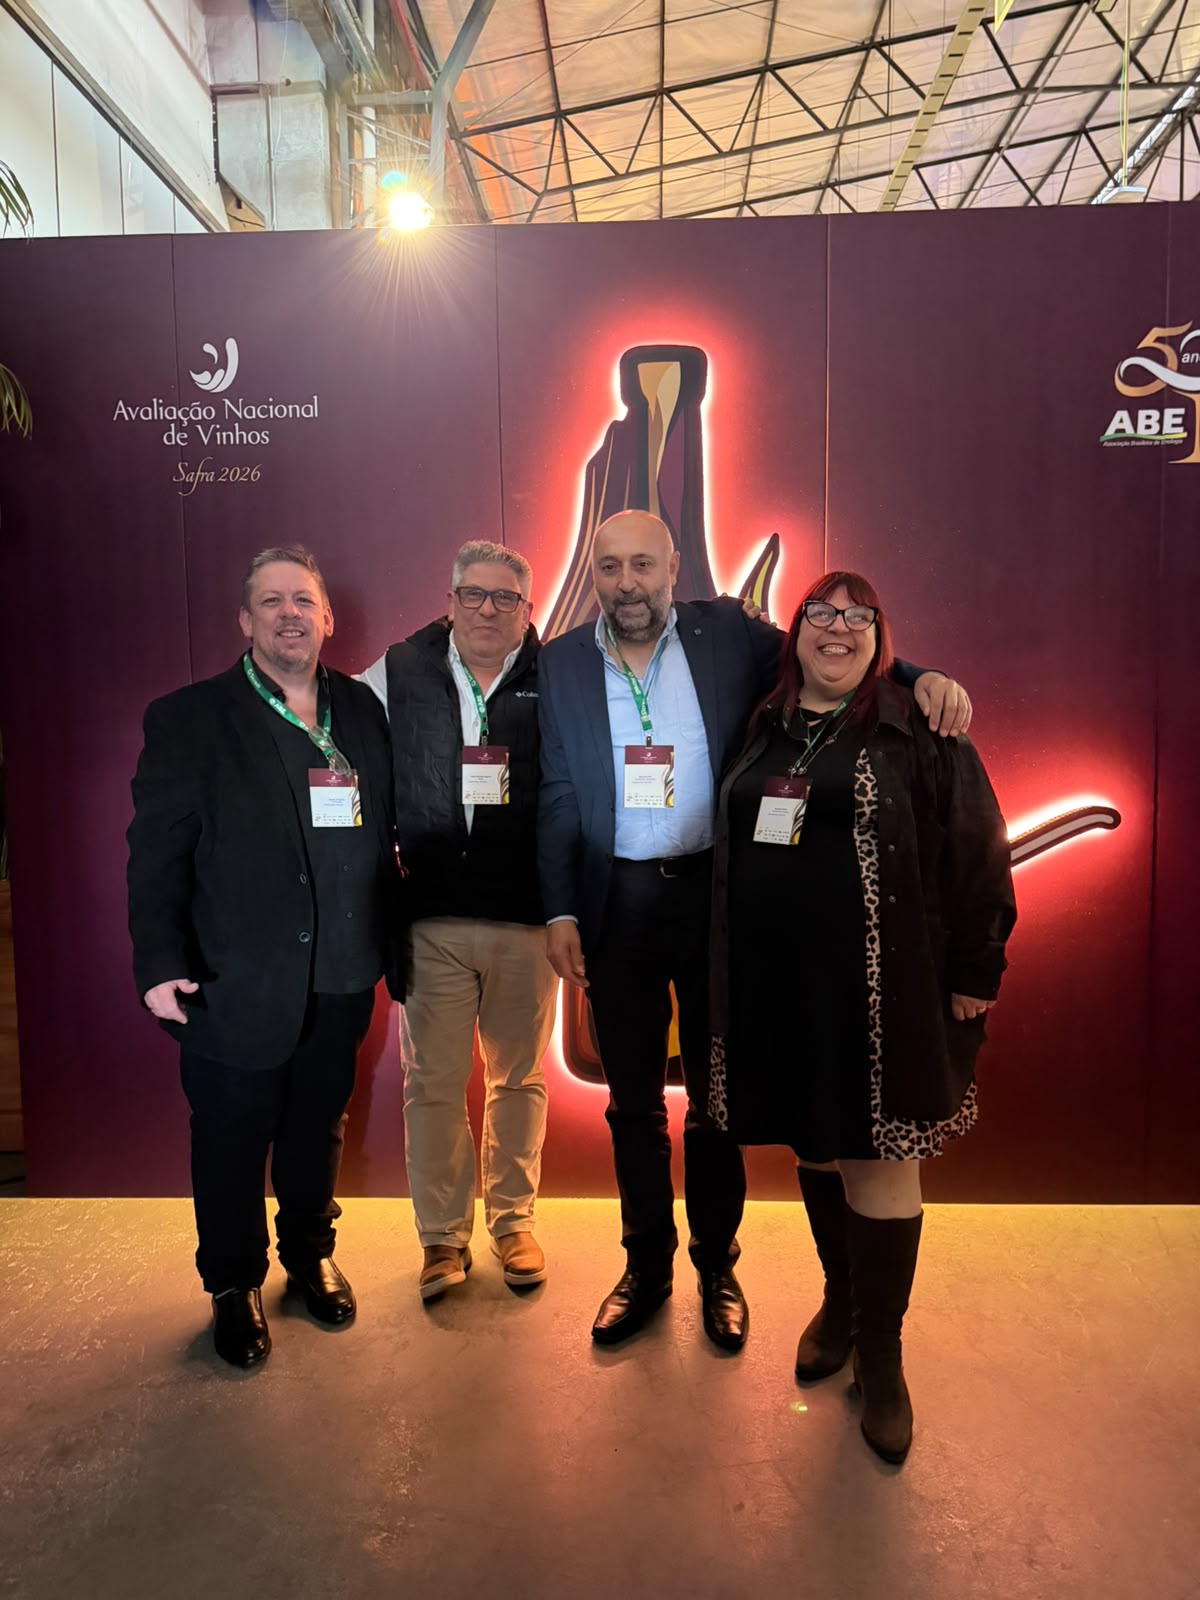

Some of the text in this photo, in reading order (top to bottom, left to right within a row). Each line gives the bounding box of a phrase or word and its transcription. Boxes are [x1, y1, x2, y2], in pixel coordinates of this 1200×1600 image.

[1181, 352, 1200, 364] an
[113, 395, 318, 426] Avaliação Nacional
[1104, 408, 1186, 435] ABE
[163, 422, 270, 446] de Vinhos
[172, 456, 263, 497] Safra 2026
